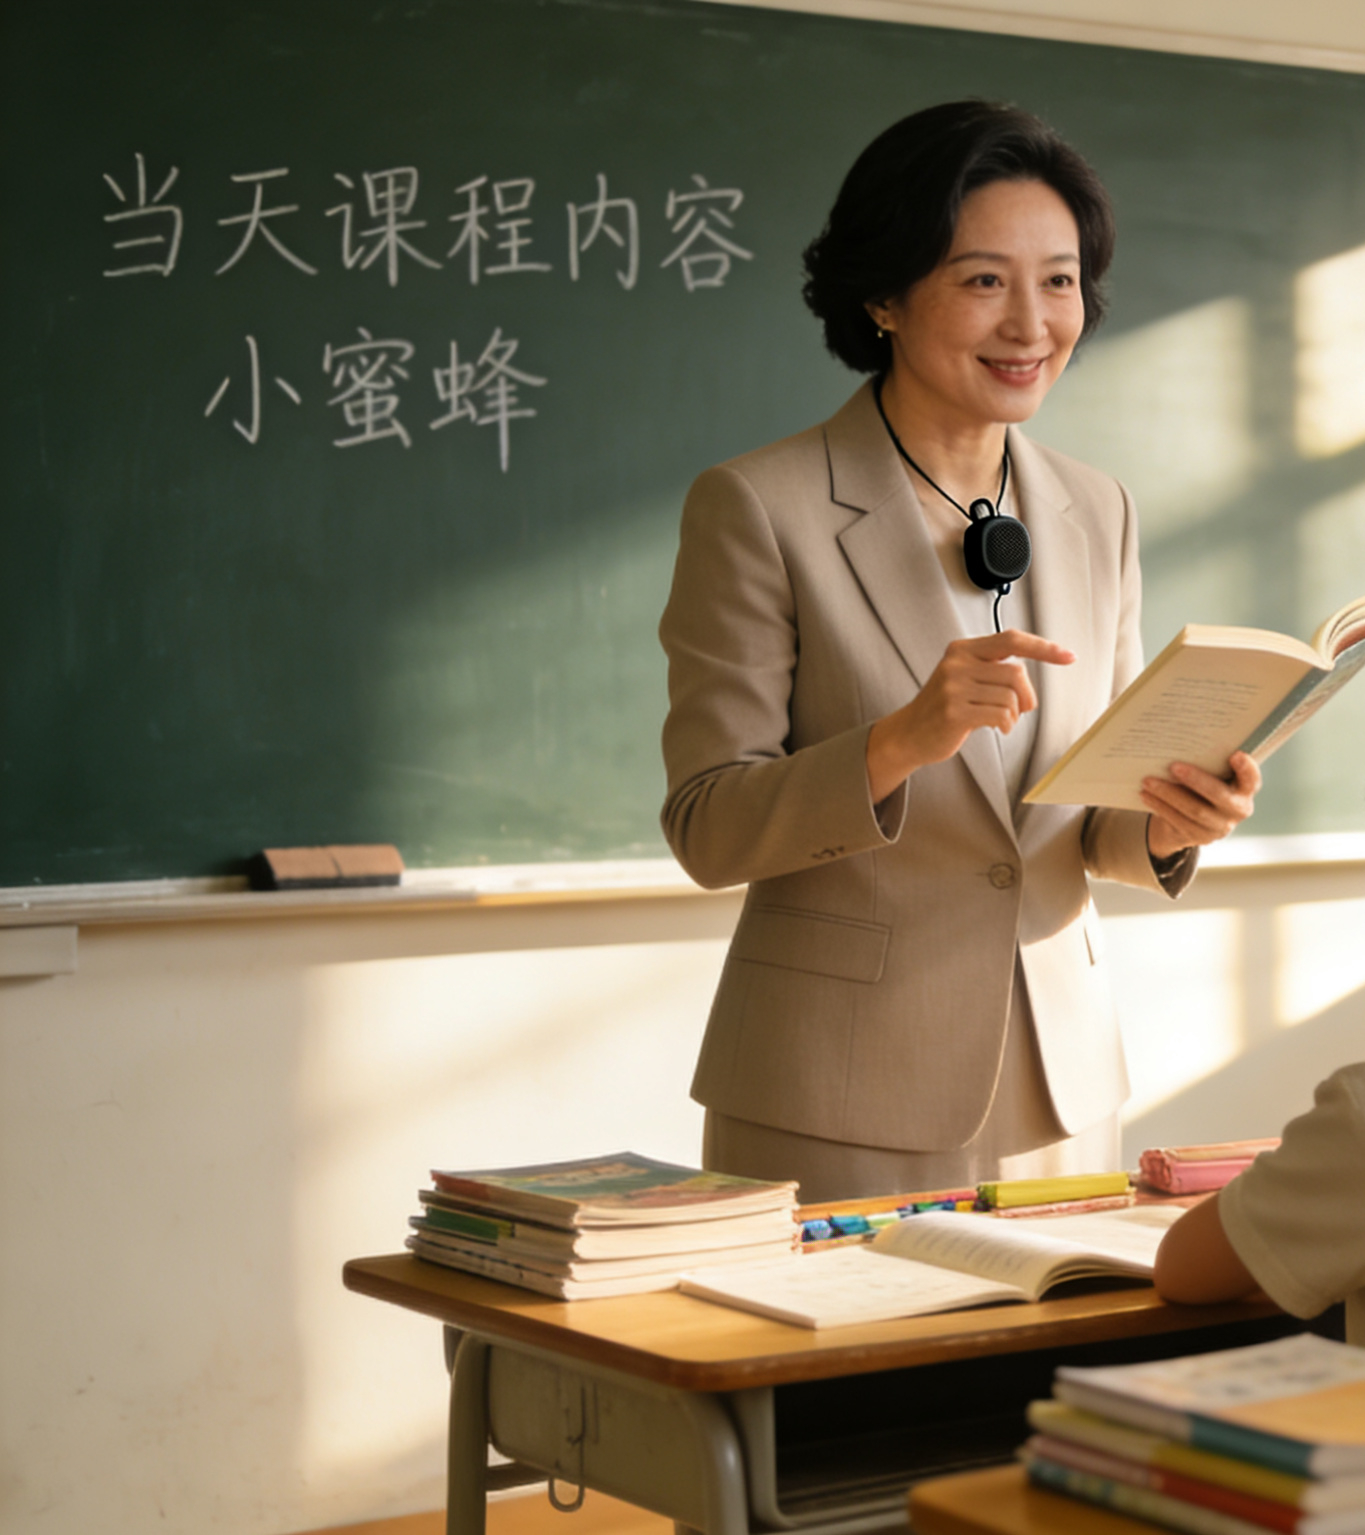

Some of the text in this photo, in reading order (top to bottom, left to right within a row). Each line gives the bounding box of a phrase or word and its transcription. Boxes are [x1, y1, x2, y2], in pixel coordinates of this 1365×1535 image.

[102, 152, 754, 291] 当天课程内容
[204, 327, 548, 473] 小蜜蜂
